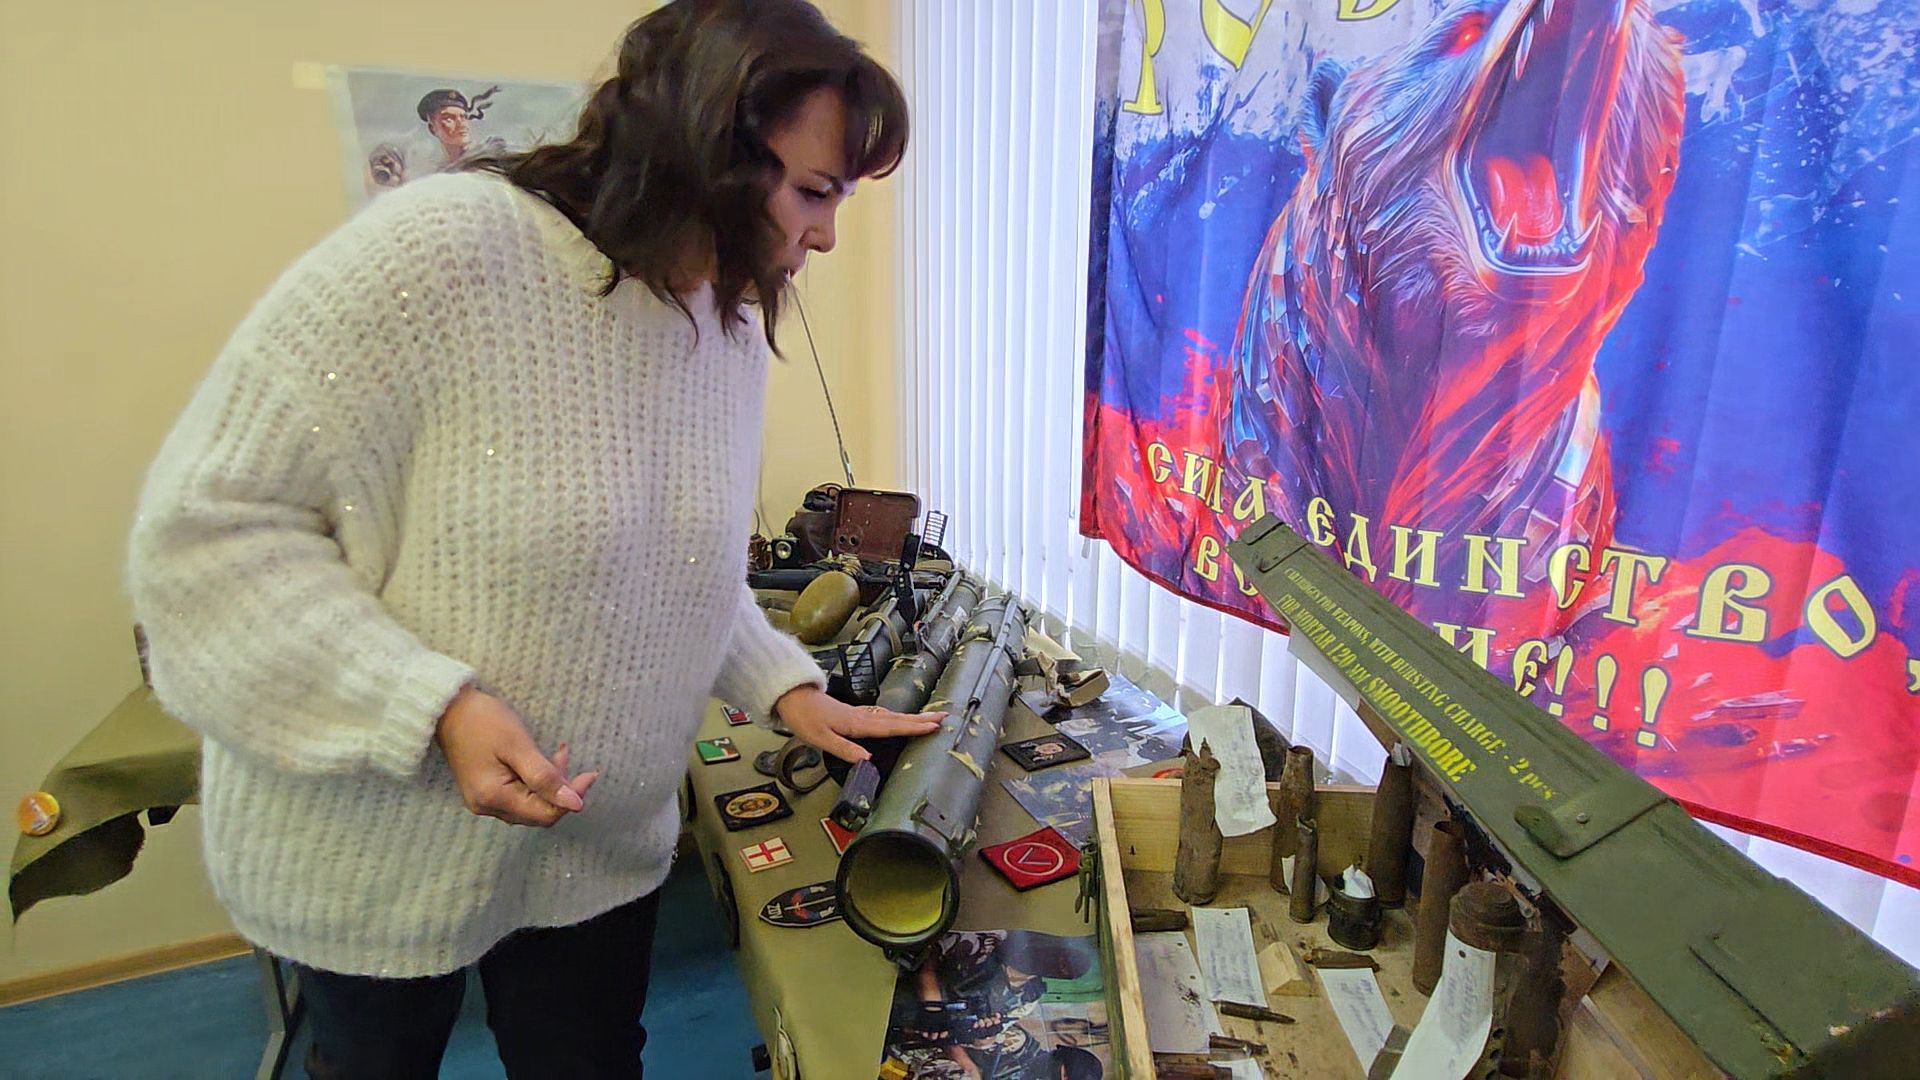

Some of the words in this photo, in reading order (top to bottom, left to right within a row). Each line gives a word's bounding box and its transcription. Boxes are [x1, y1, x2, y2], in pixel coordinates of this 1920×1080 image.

[1147, 442, 1266, 522] СИЛА
[1276, 593, 1301, 615] FOR
[1293, 607, 1337, 650] MORTAR
[1326, 642, 1357, 669] 120
[1361, 677, 1477, 782] SMOOTHBORE
[1332, 607, 1372, 645] WEAPONS,
[1369, 637, 1398, 663] WITH
[1391, 657, 1449, 706] BURSTING
[1444, 703, 1506, 754] CHARGE
[1508, 757, 1530, 775] 2
